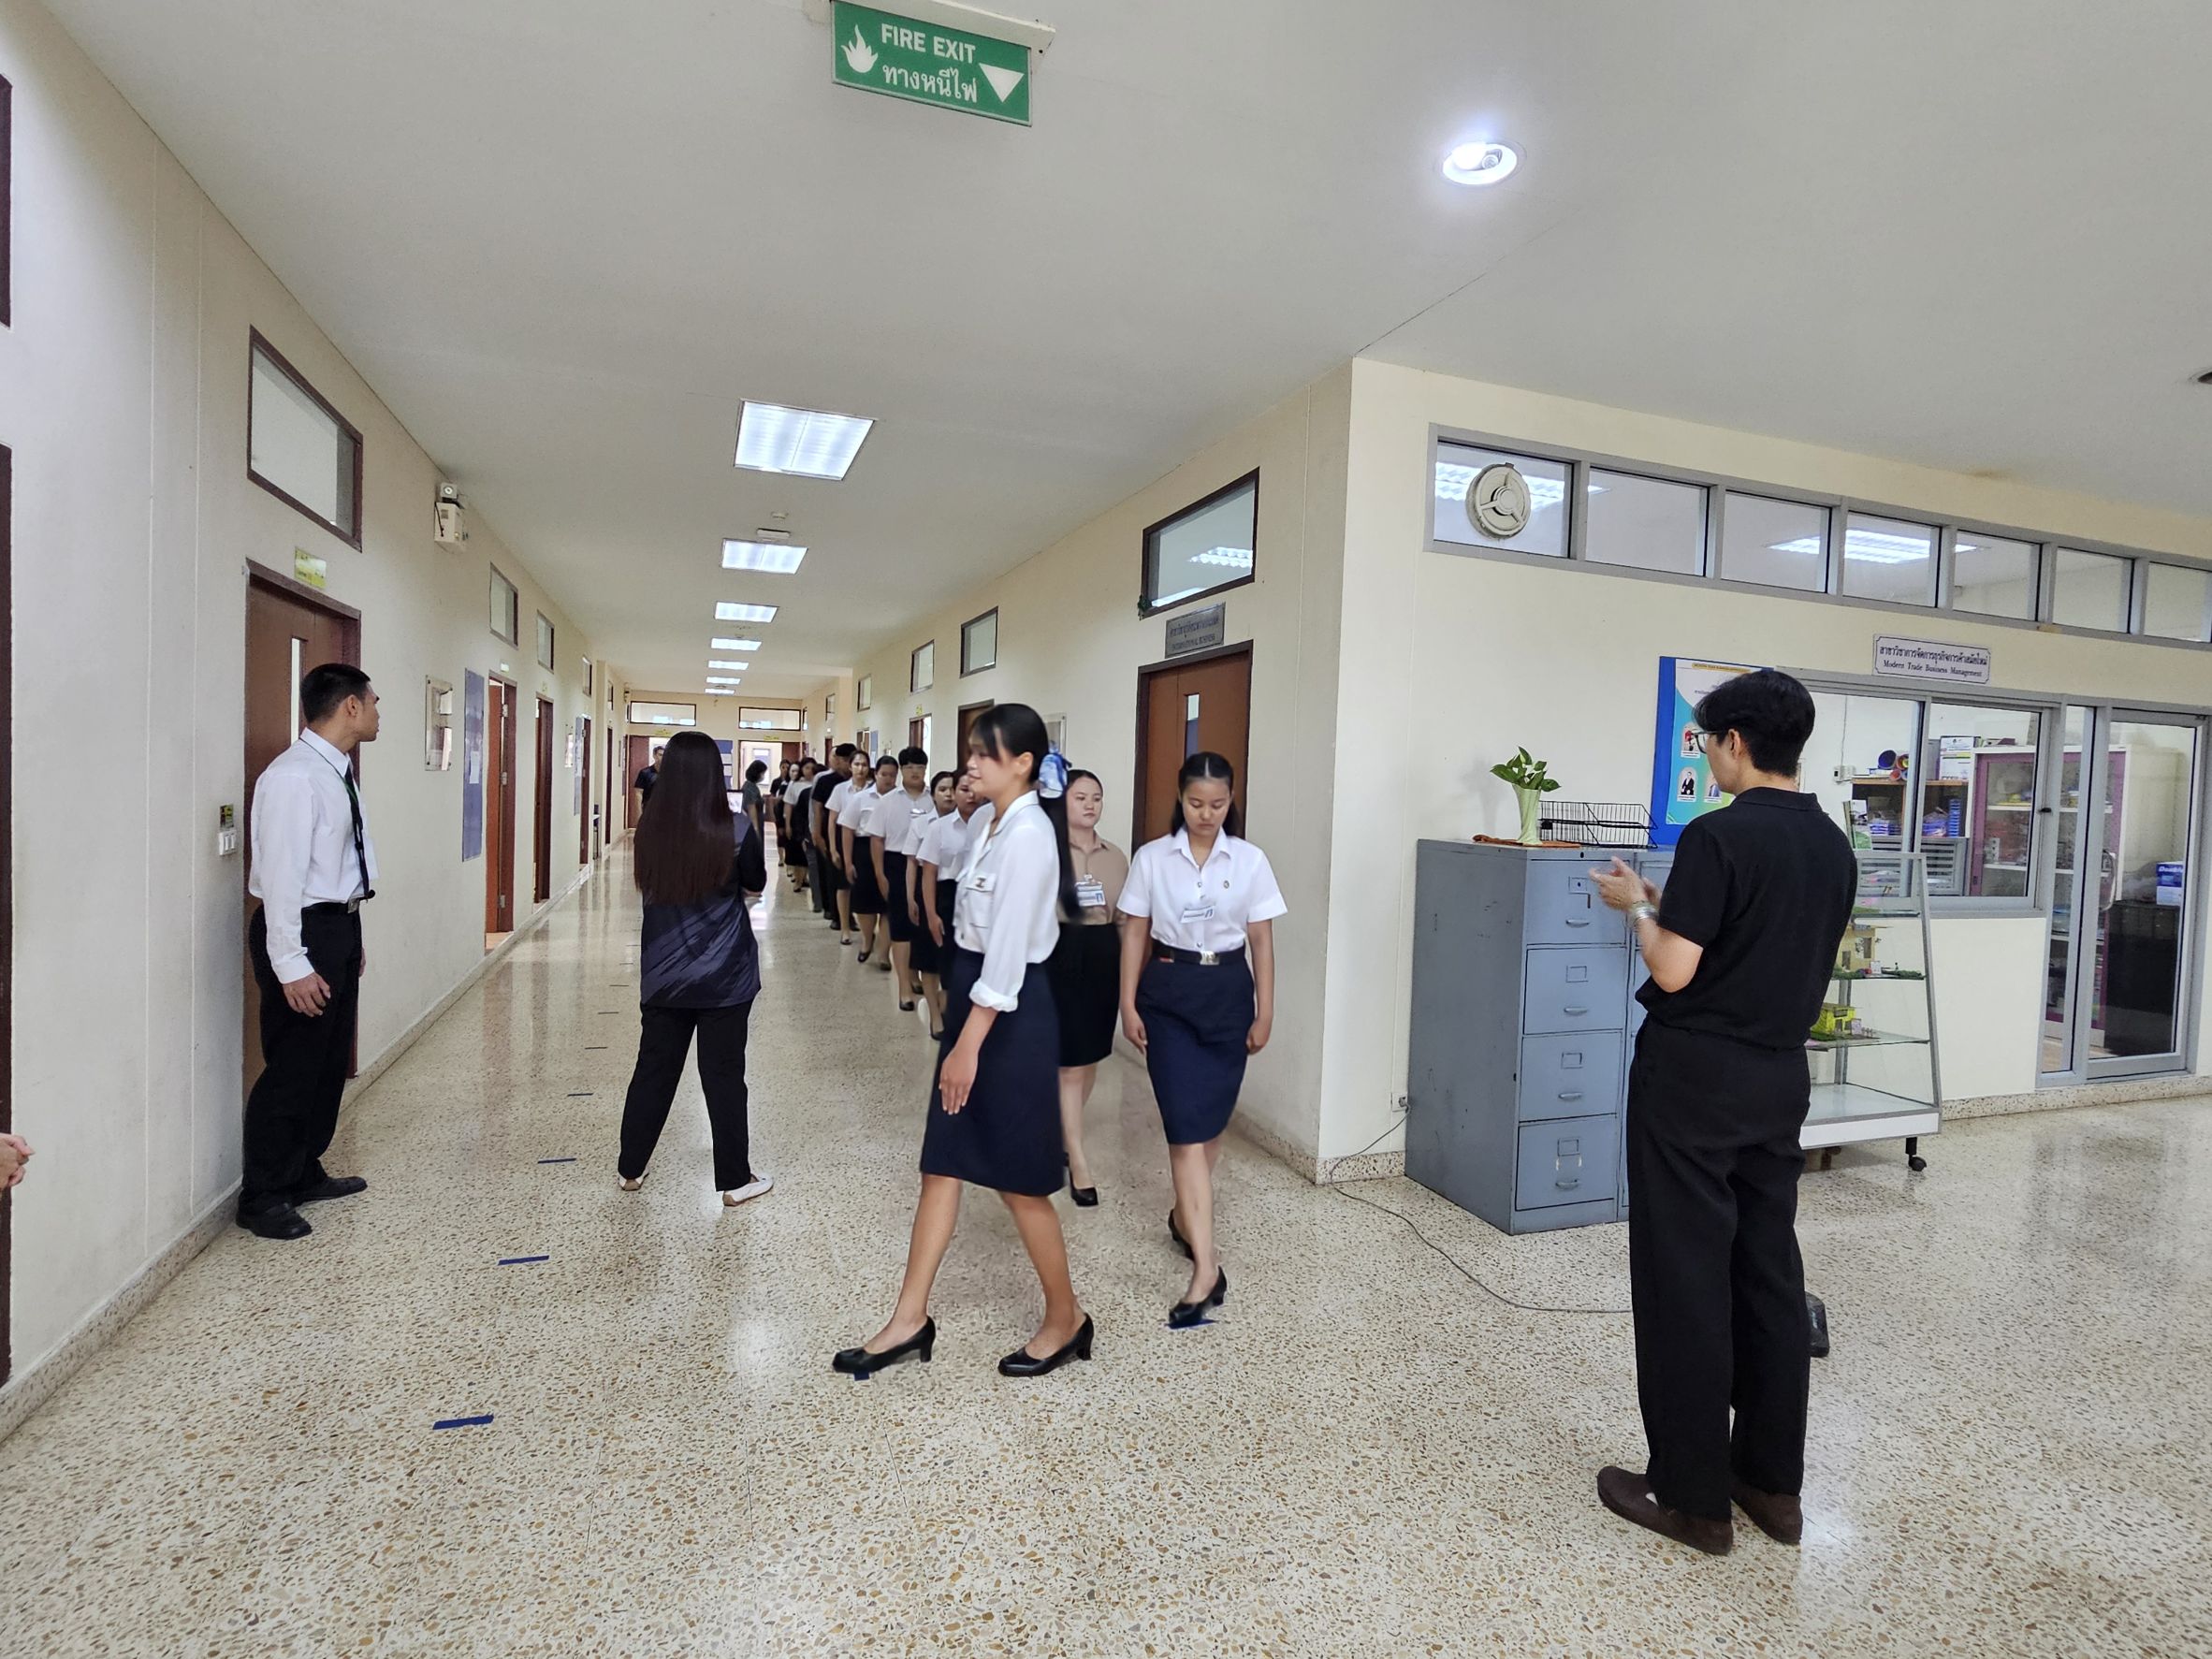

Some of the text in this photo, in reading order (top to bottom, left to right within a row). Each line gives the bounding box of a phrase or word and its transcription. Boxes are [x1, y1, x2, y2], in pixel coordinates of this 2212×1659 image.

[881, 23, 976, 64] FIRE EXIT
[882, 65, 977, 103] ทางหนีไฟ
[1884, 660, 1982, 677] Modern Trade Business Management
